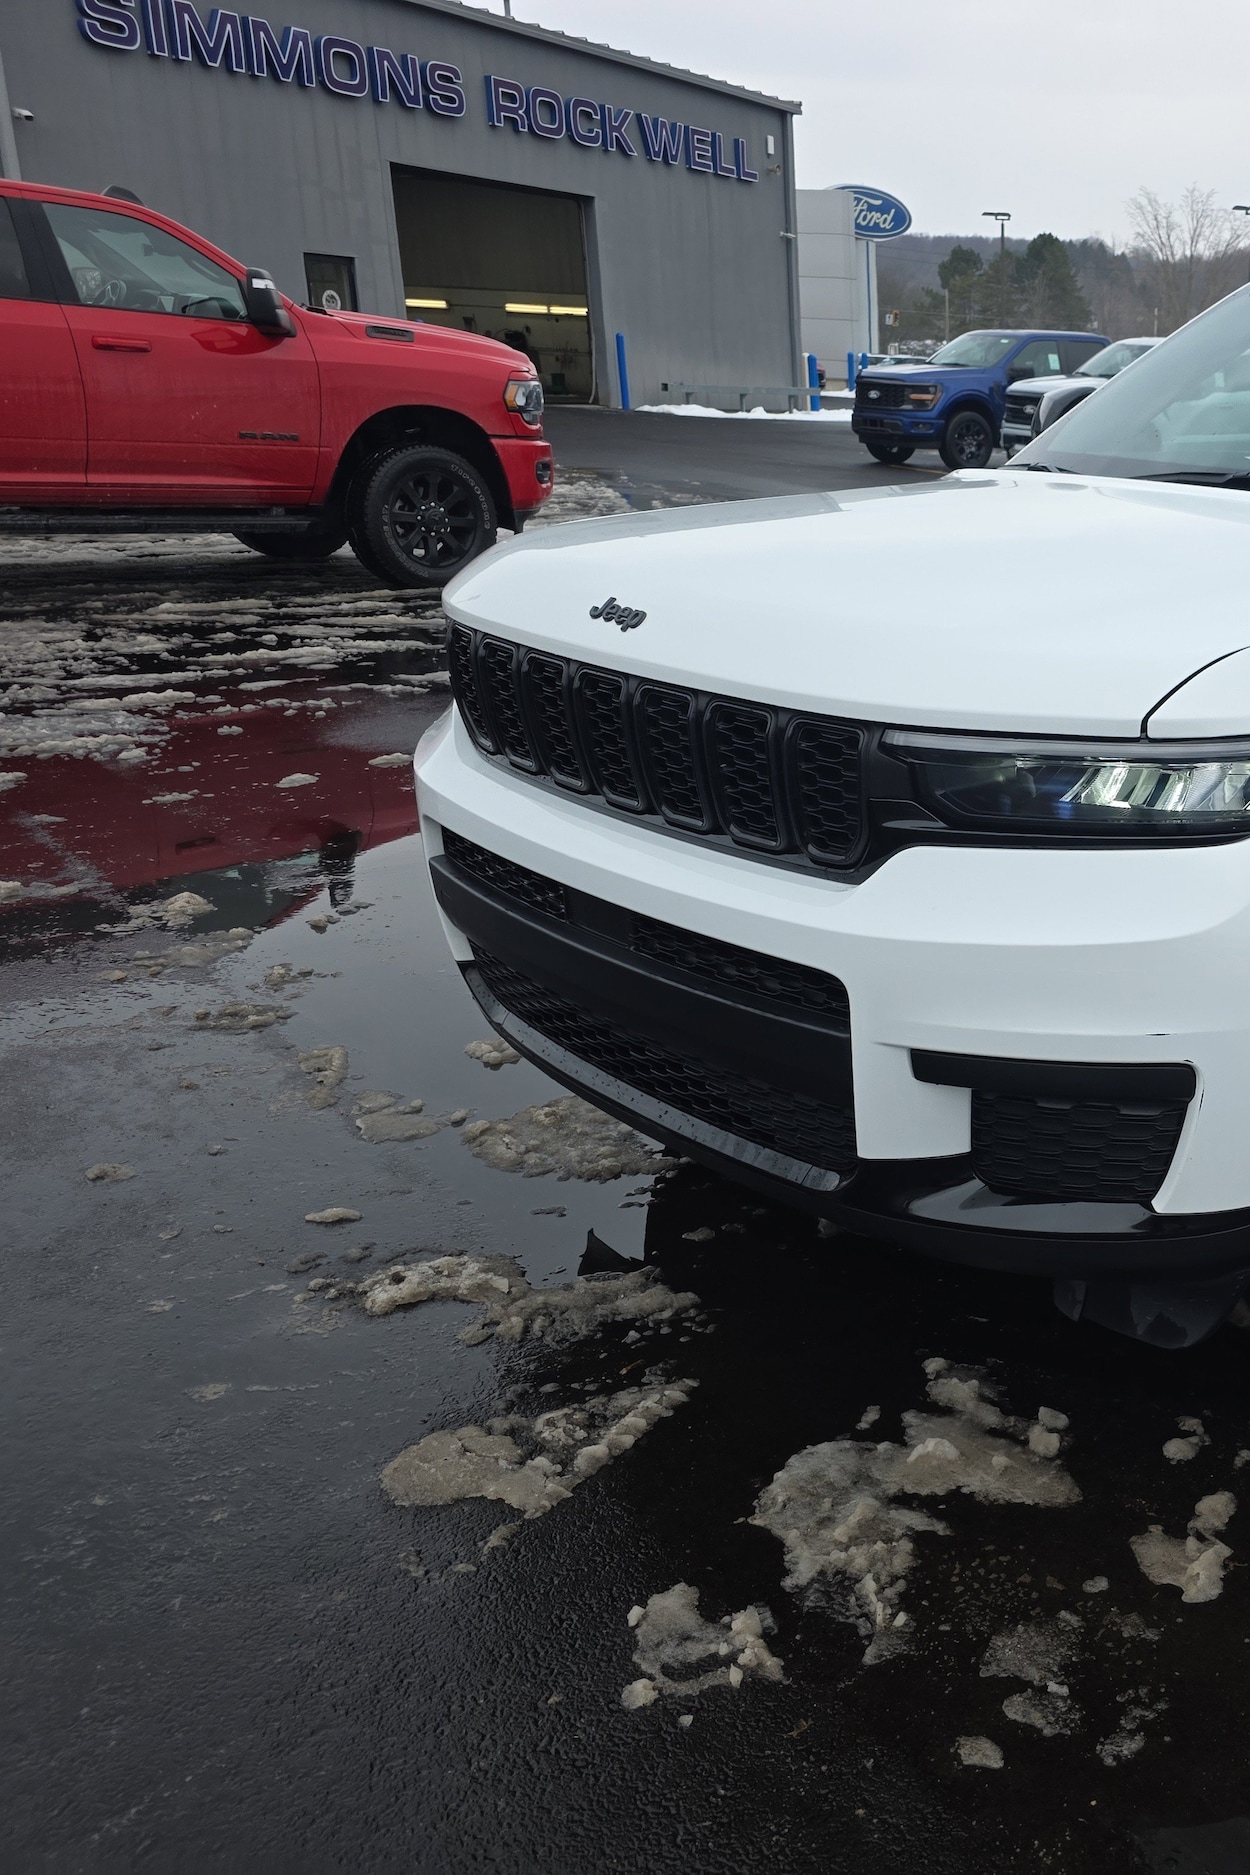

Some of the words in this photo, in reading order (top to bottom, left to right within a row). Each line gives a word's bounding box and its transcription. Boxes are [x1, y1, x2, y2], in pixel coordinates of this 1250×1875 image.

[78, 0, 466, 117] SIMMONS
[852, 194, 895, 229] Ford
[589, 596, 647, 633] Jeep
